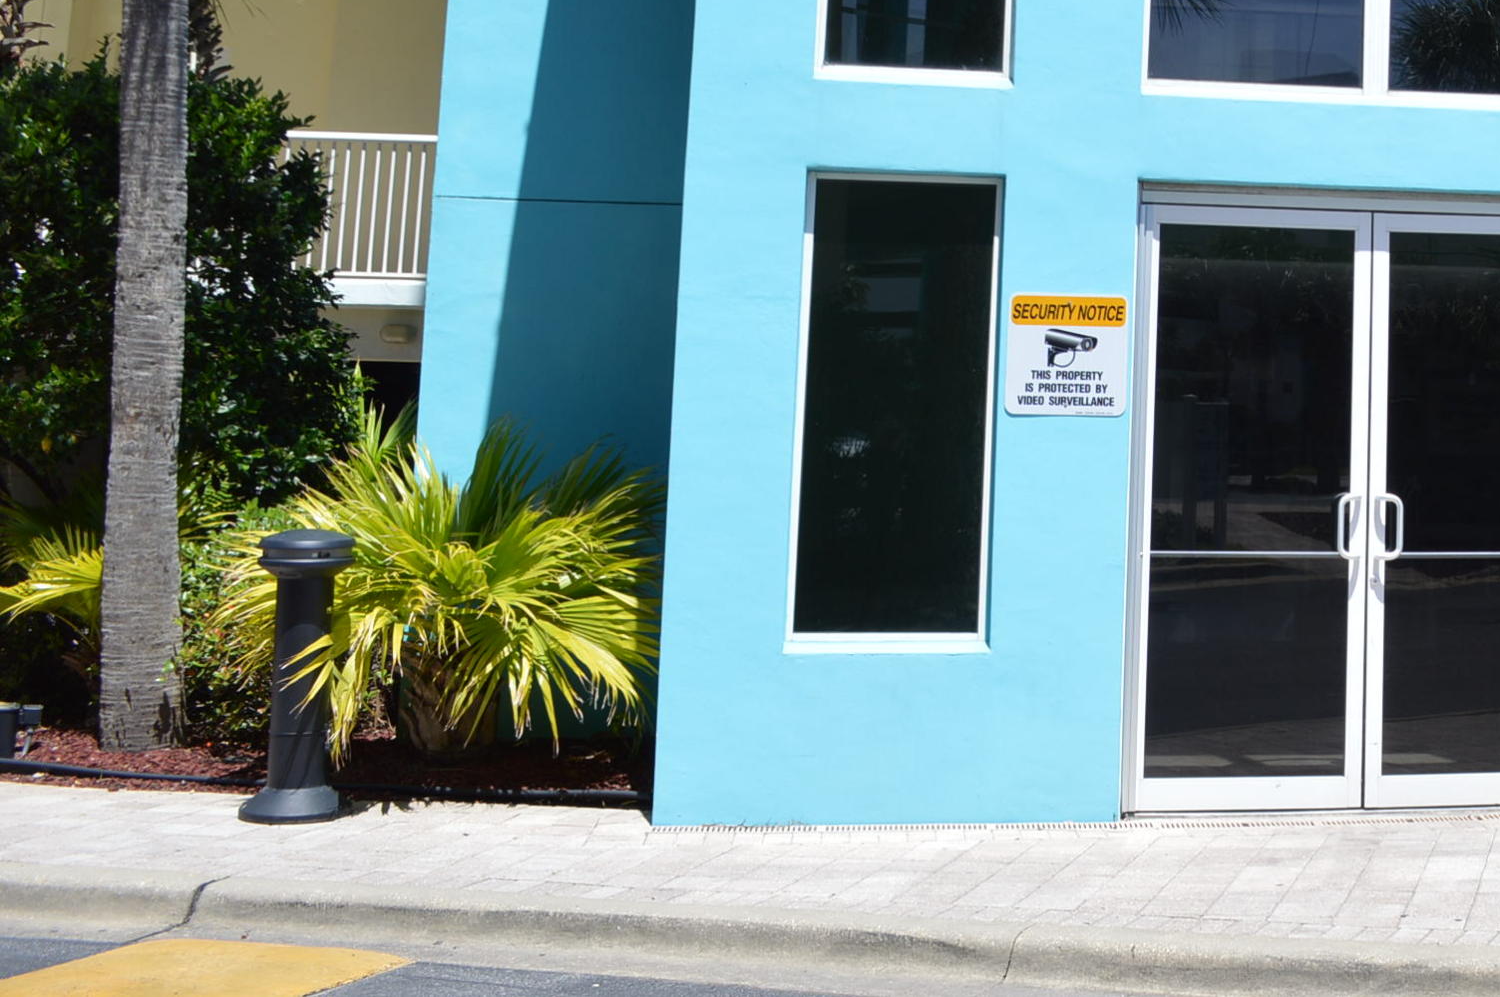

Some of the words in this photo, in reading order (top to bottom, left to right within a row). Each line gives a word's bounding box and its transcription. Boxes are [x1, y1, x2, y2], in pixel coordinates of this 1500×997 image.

[1012, 302, 1076, 320] SECURITY
[1077, 304, 1125, 321] NOTICE
[1031, 370, 1051, 380] THIS
[1055, 370, 1103, 381] PROPERTY
[1025, 382, 1034, 392] IS
[1038, 383, 1091, 393] PROTECTED
[1095, 384, 1108, 394] BY
[1017, 395, 1045, 405] VIDEO
[1048, 396, 1115, 407] SURVEILLANCE
